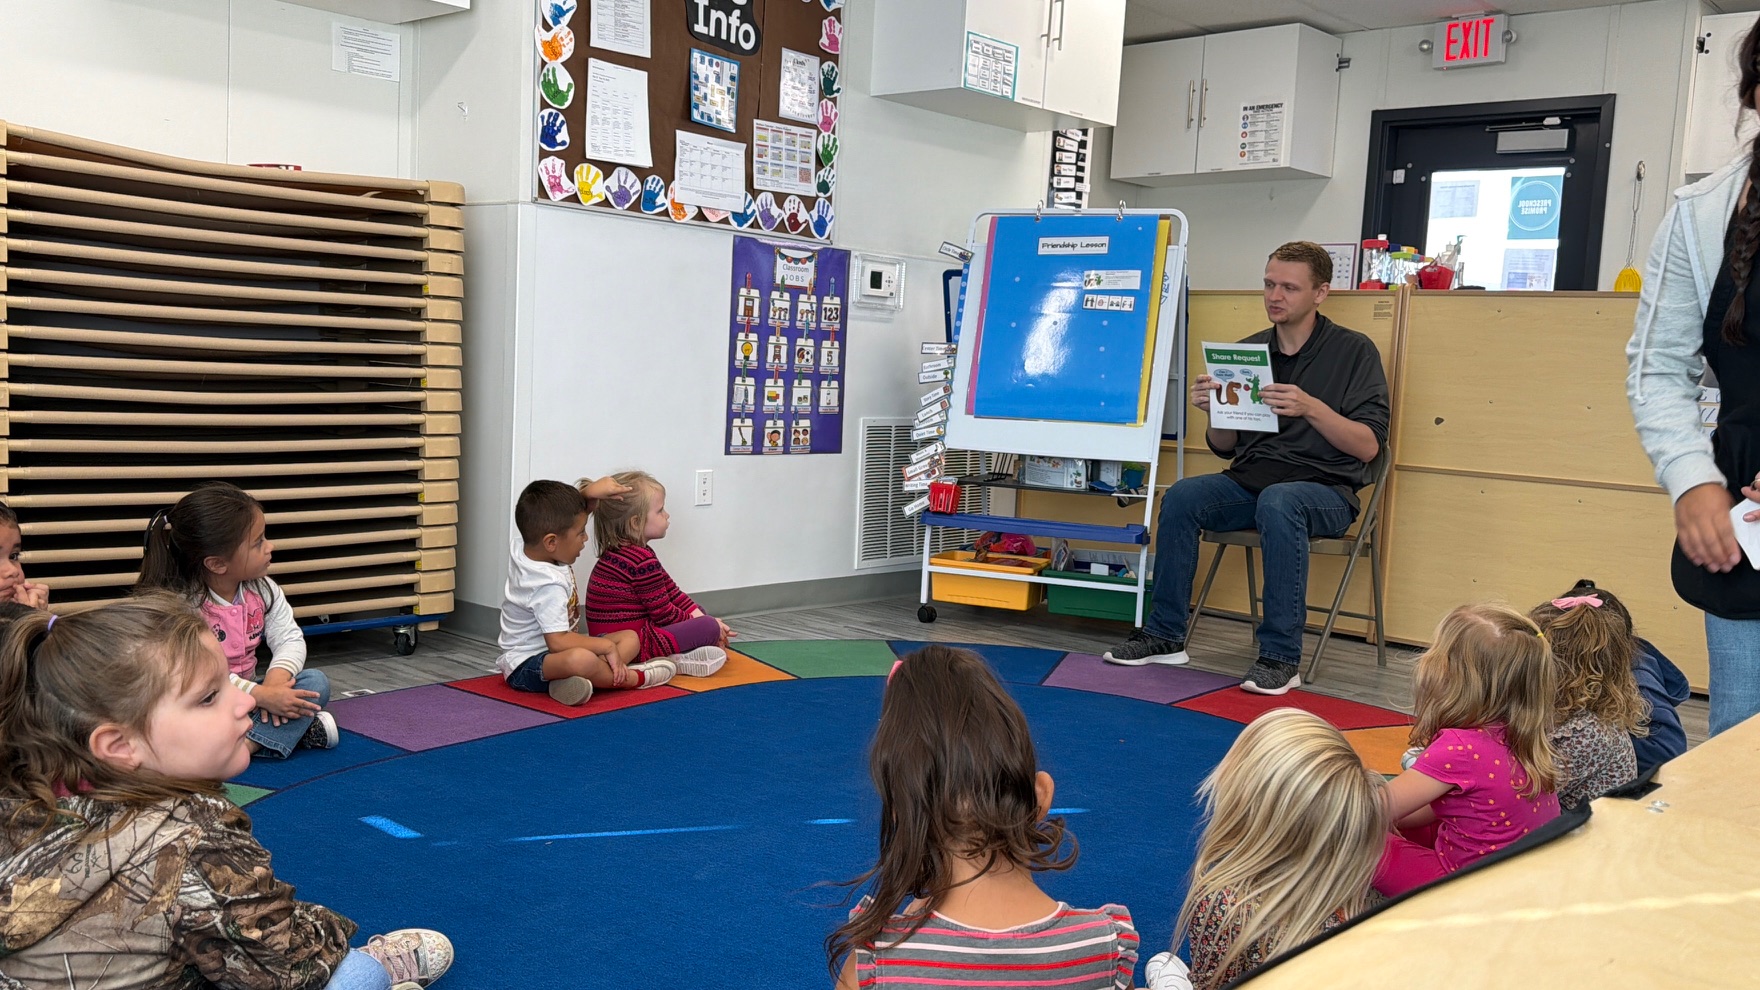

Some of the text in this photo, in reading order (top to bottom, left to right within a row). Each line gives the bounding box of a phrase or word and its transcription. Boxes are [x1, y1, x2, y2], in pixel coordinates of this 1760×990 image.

[693, 0, 756, 51] Info
[1444, 17, 1496, 62] EXIT
[1256, 102, 1284, 110] EMERGENCY
[1041, 241, 1078, 251] Friendship
[782, 264, 810, 273] Classroom
[823, 307, 839, 322] 123
[1232, 354, 1260, 362] Request
[922, 409, 933, 418] Lunch
[915, 500, 925, 508] Home
